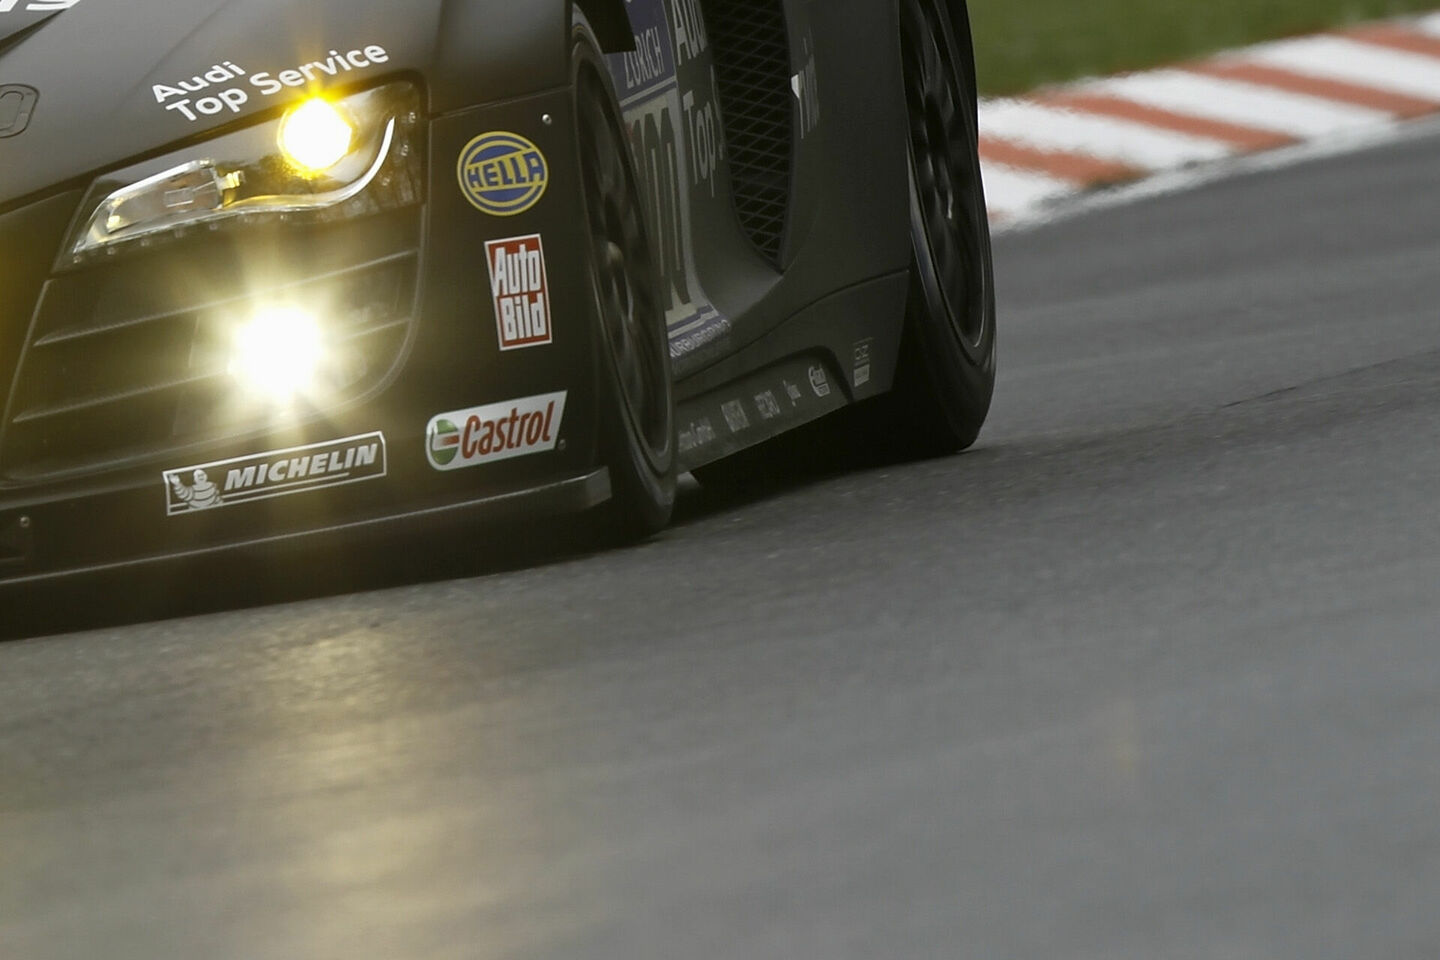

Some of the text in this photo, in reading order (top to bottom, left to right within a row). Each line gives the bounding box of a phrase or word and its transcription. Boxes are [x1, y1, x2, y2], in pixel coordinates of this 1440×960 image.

[152, 60, 246, 103] Audi
[165, 43, 390, 122] Top Service
[466, 148, 544, 189] HELLA
[682, 89, 718, 198] Top
[493, 244, 542, 297] Auto
[498, 292, 547, 341] Bild
[462, 401, 555, 459] Castrol
[224, 443, 377, 492] MICHELIN
